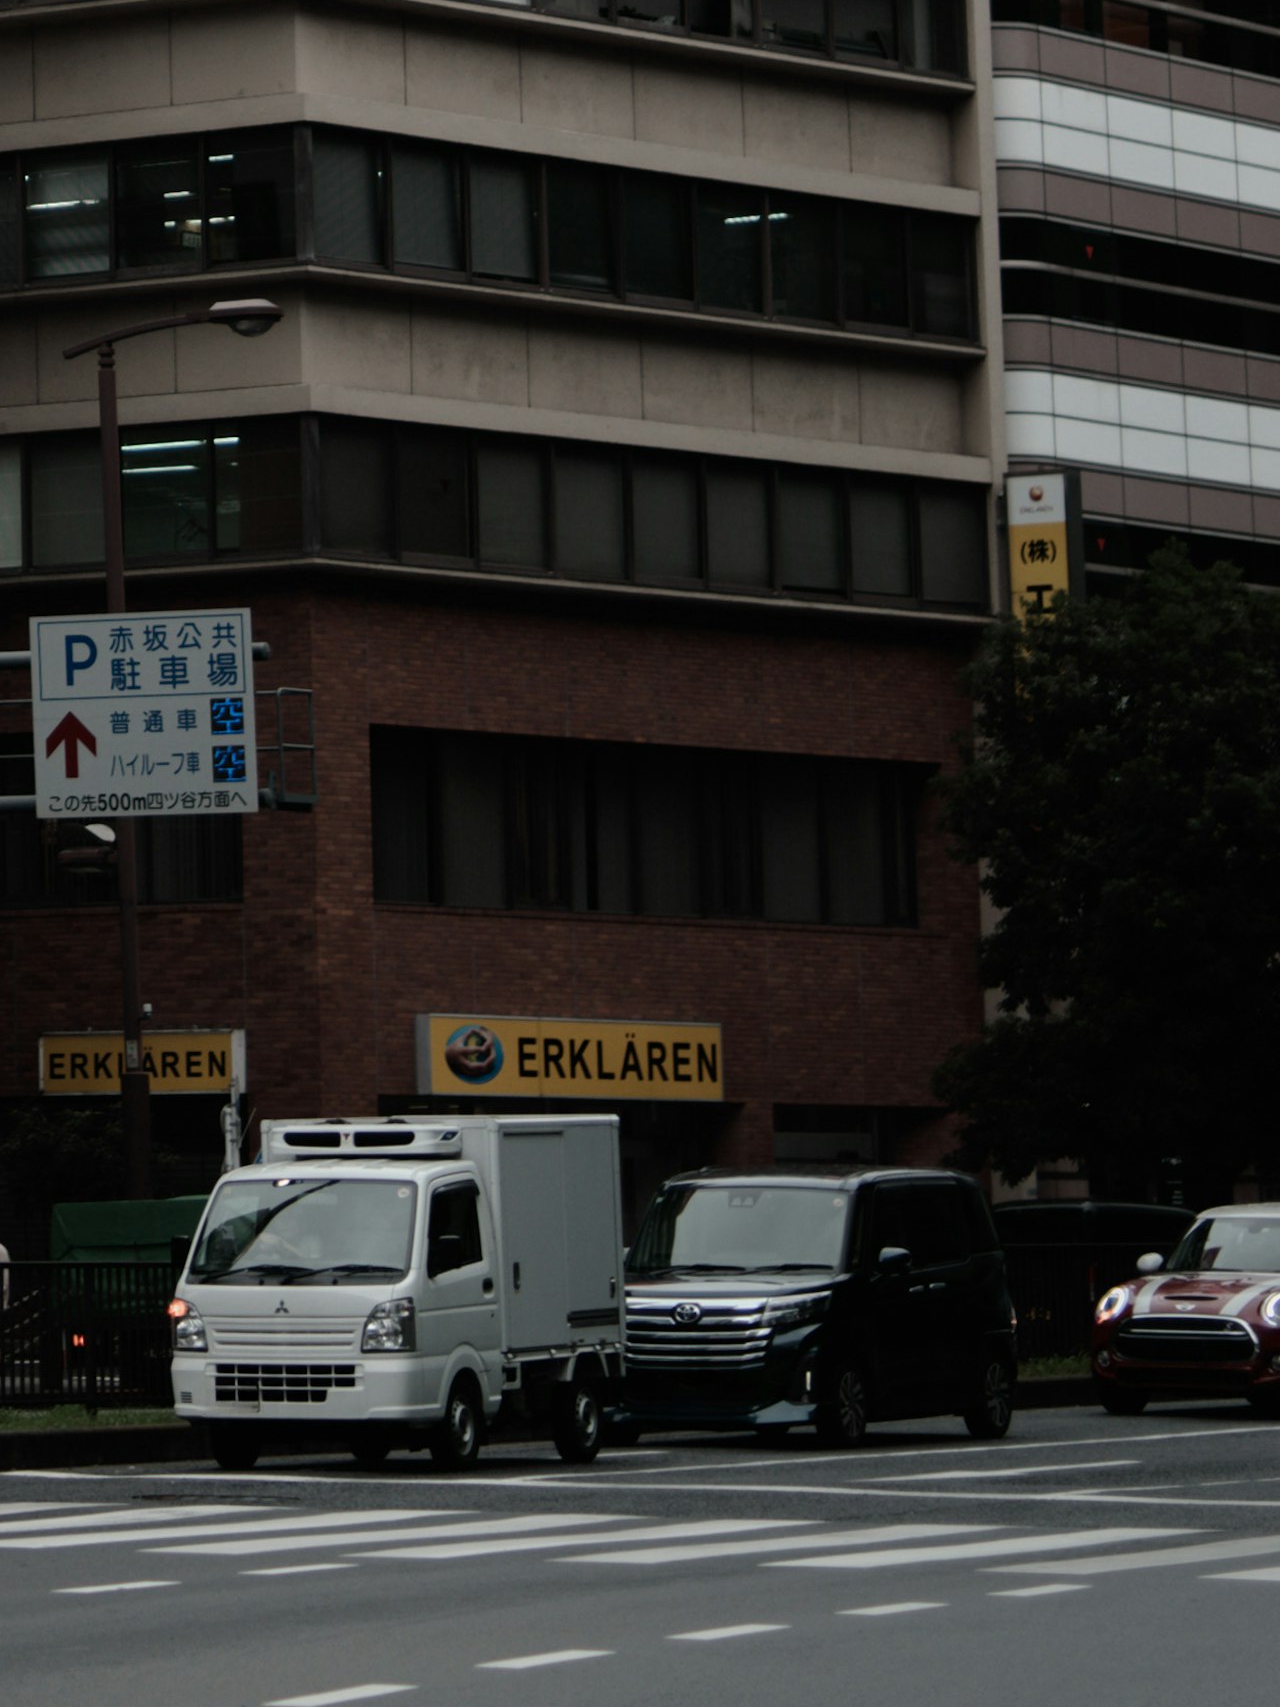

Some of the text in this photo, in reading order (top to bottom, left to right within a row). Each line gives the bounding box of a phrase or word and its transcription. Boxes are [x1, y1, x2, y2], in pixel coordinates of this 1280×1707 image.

[109, 622, 237, 654] 赤坂公共
[65, 634, 98, 686] P
[110, 652, 238, 691] 駐車場
[109, 698, 244, 734] 普通車 空
[109, 746, 247, 782] ハイルーフ車 空
[517, 1033, 719, 1084] ERKLÄREN
